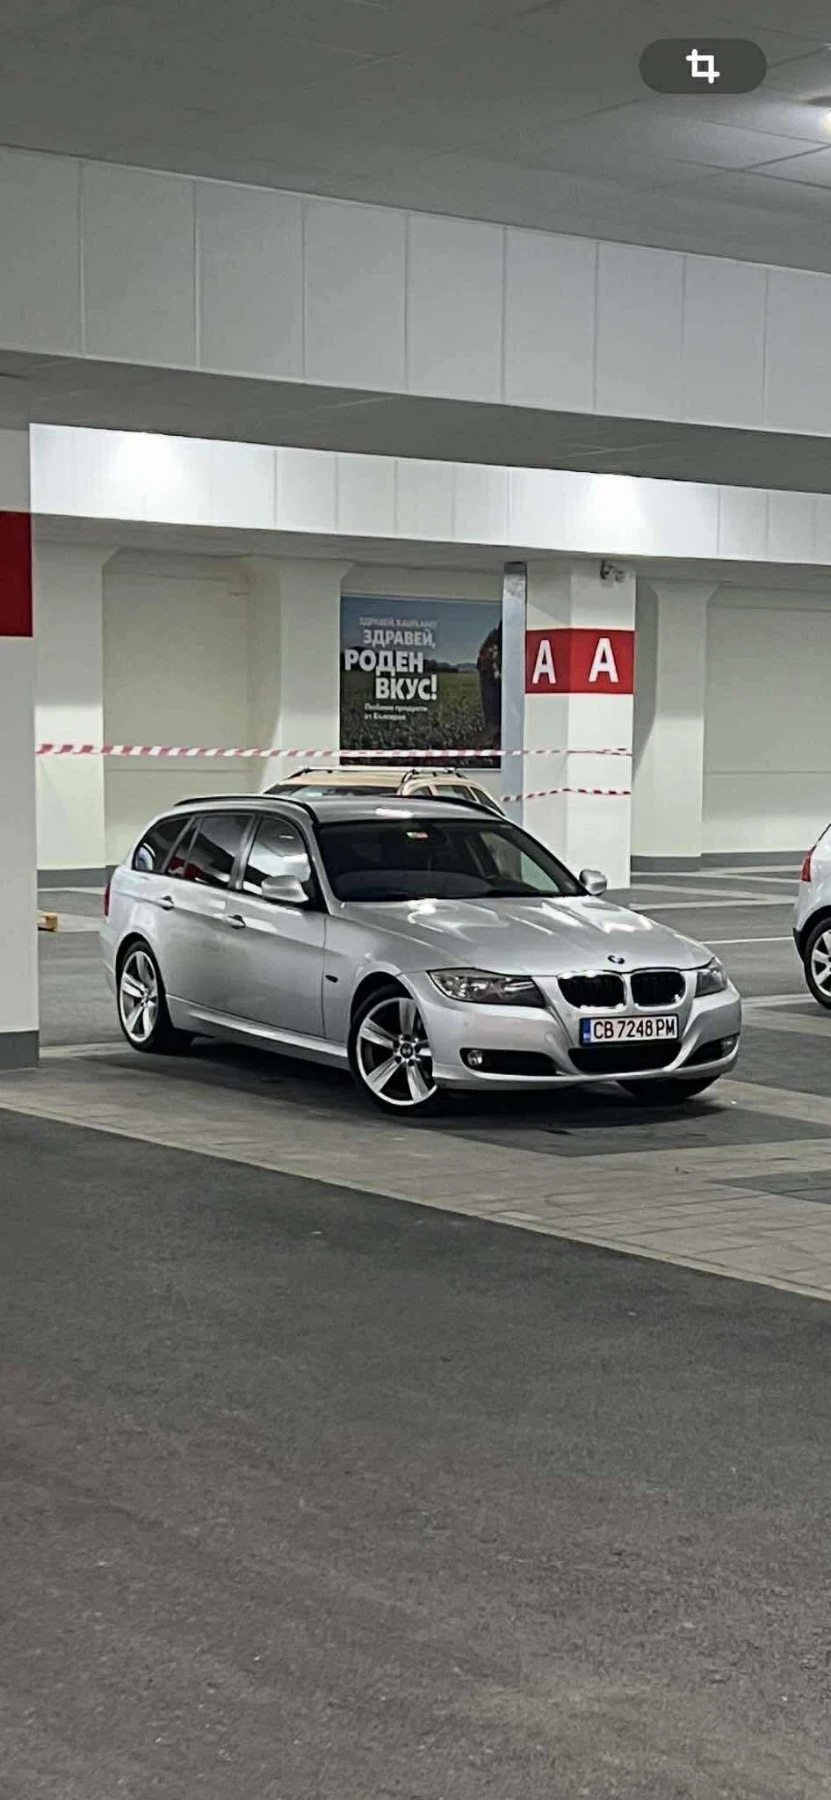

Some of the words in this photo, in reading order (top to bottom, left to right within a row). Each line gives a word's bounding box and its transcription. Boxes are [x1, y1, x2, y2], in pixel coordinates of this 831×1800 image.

[363, 628, 436, 649] ЗДРАВЕЙ,
[344, 648, 424, 677] РОДЕН
[531, 639, 557, 684] A
[588, 637, 619, 683] A
[375, 674, 437, 701] ВКУС!
[593, 1020, 614, 1039] CB
[617, 1020, 653, 1038] 7248
[656, 1018, 675, 1036] PM
